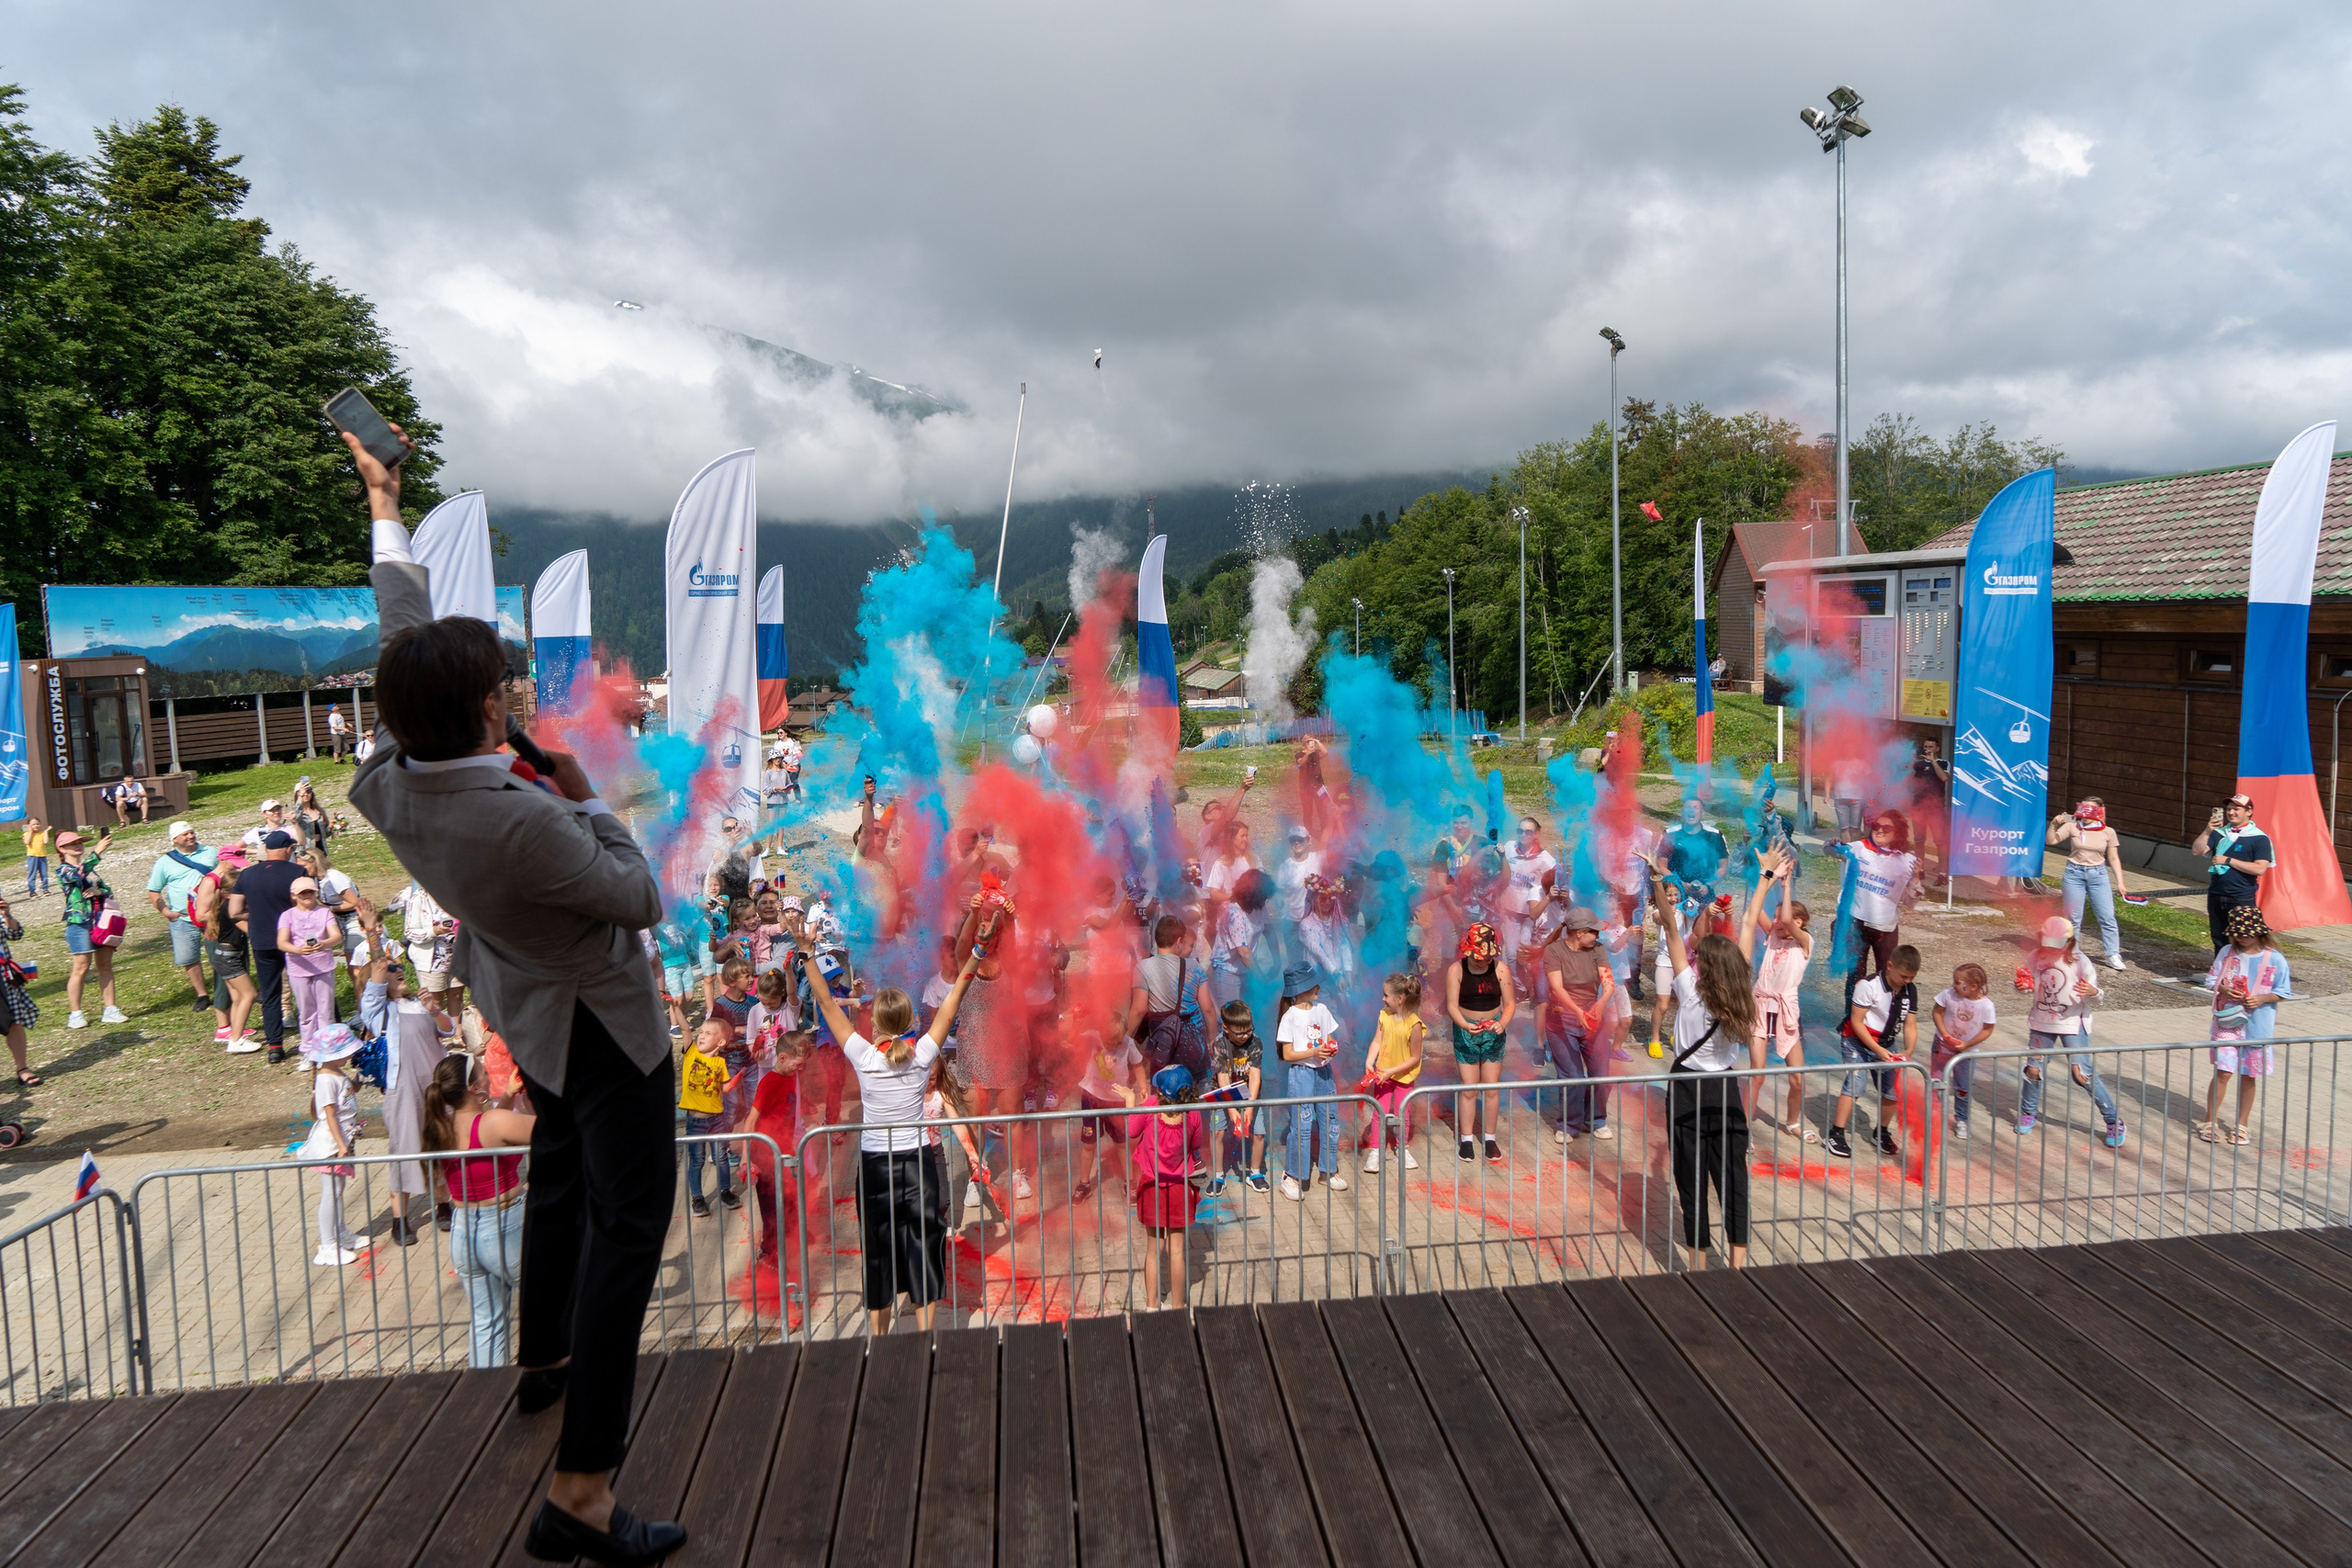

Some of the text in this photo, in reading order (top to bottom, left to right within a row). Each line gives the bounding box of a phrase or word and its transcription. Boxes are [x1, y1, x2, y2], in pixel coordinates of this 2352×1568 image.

[705, 574, 740, 586] ГАЗПРОМ
[1998, 575, 2038, 586] ГАЗПРОМ
[47, 665, 70, 781] ФОТОСЛУЖБА
[1971, 827, 2026, 841] Курорт
[1965, 842, 2029, 857] Газпром
[1869, 873, 1896, 888] САМЫЙ
